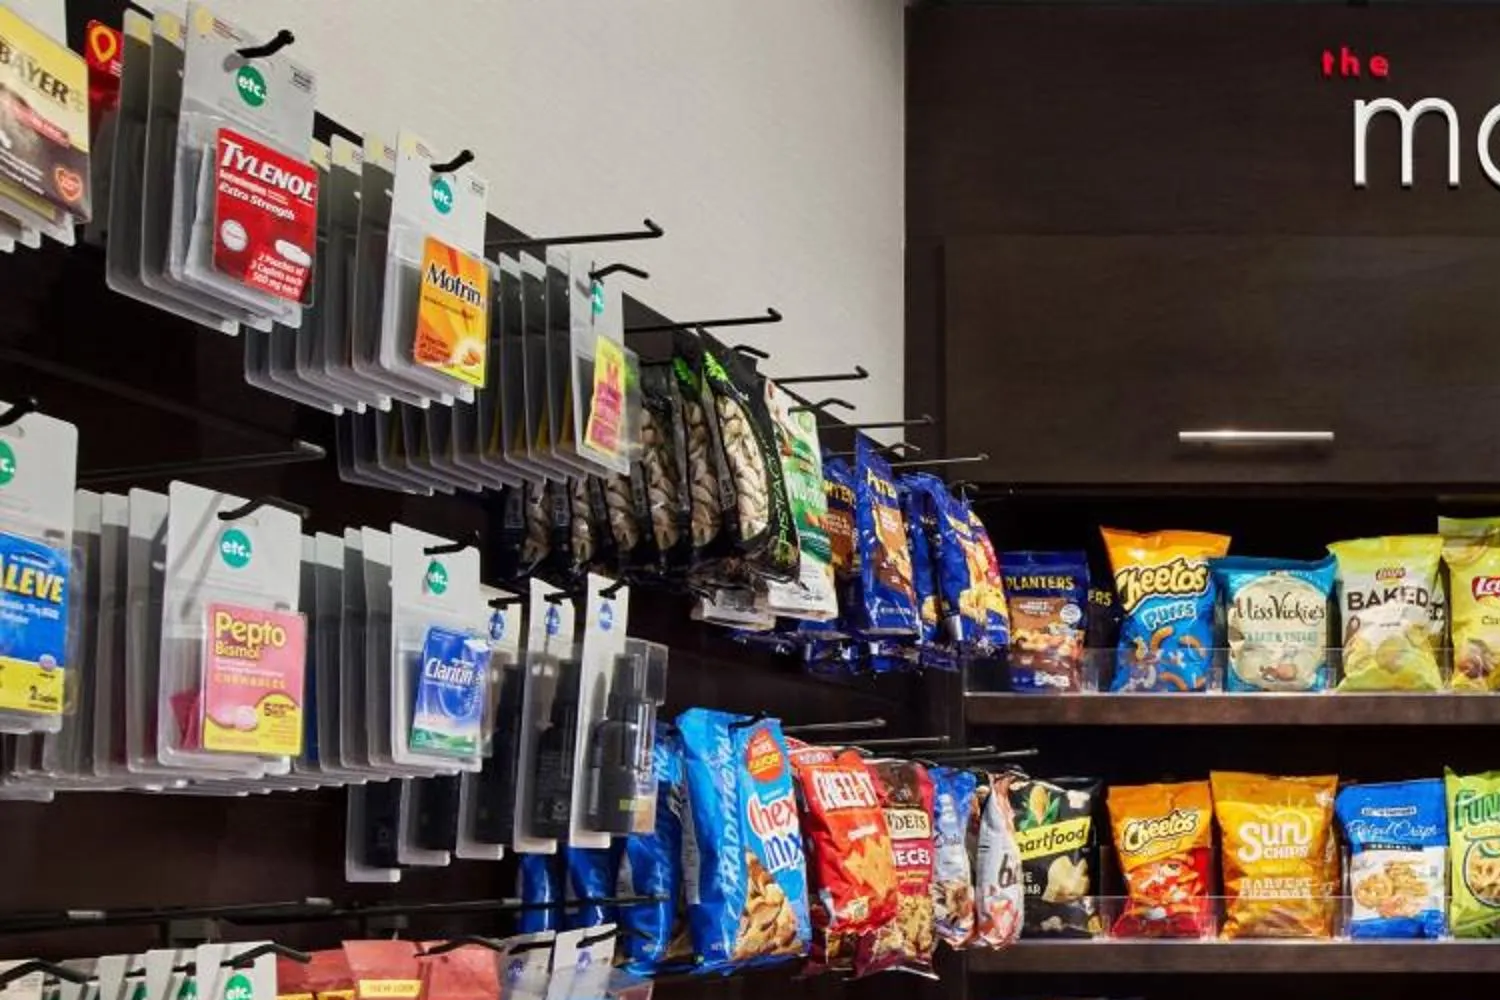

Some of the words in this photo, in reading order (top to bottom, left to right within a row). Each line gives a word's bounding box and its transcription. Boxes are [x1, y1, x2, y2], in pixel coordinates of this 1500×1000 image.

[1321, 46, 1389, 77] the
[219, 137, 317, 202] TYLENOL
[219, 182, 249, 202] Extra
[250, 193, 295, 221] Strength
[425, 262, 481, 305] Motrin
[222, 541, 251, 559] etc.
[1006, 574, 1075, 591] PLANTERS
[1115, 557, 1209, 612] Cheetos
[1142, 600, 1198, 630] PUFFS
[1272, 592, 1326, 626] Vickie's
[1346, 590, 1429, 611] BAKED
[215, 611, 287, 648] Pepto
[215, 640, 261, 659] Bismol
[425, 657, 473, 684] Claritin
[1020, 824, 1087, 853] artfood
[1121, 809, 1200, 852] Cheetos
[1238, 813, 1313, 862] Sun
[226, 985, 253, 1000] etc.
